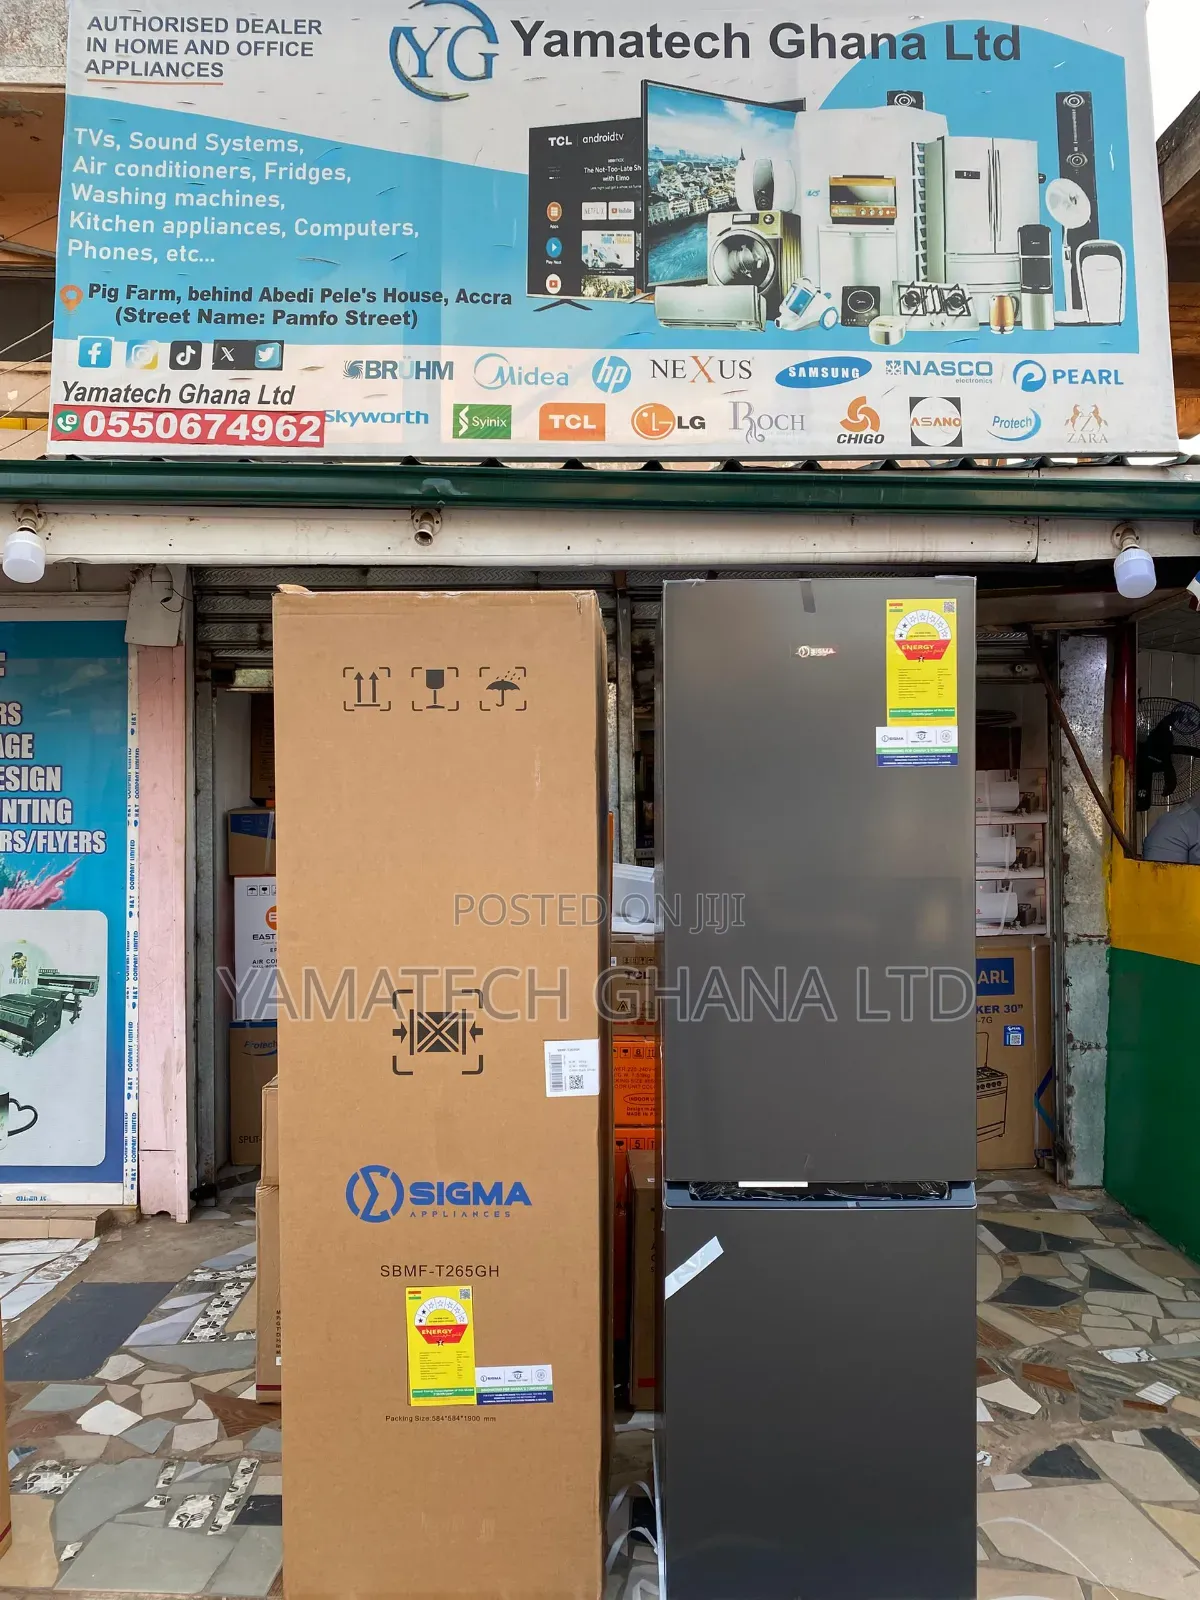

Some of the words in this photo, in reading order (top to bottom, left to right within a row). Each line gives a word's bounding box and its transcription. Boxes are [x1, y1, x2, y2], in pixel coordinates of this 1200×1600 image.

[87, 16, 229, 33] AUTHORISED
[235, 18, 323, 35] DEALER
[86, 37, 107, 53] IN
[115, 38, 178, 55] HOME
[184, 40, 230, 56] AND
[237, 41, 314, 57] OFFICE
[511, 20, 752, 60] Yamatech
[770, 21, 928, 61] Ghana
[946, 23, 1021, 62] Ltd
[85, 59, 224, 78] APPLIANCES
[74, 127, 121, 150] TVs,
[129, 131, 198, 152] Sound
[205, 132, 304, 157] Systems,
[548, 136, 572, 147] TCL
[582, 132, 625, 144] androidtv
[72, 156, 107, 175] Air
[114, 159, 256, 183] conditioners,
[264, 162, 352, 185] Fridges,
[71, 184, 166, 209] Washing
[174, 189, 285, 211] machines,
[69, 211, 154, 233] Kitchen
[163, 215, 286, 238] appliances,
[294, 219, 420, 241] Computers,
[67, 239, 159, 265] Phones,
[166, 245, 215, 263] etc...
[88, 284, 119, 304] Pig
[126, 286, 182, 305] Farm,
[188, 286, 253, 304] behind
[259, 288, 315, 304] Abedi
[320, 288, 377, 305] Pele's
[383, 288, 449, 307] House,
[455, 289, 512, 306] Accra
[115, 308, 190, 329] (Street
[197, 309, 265, 326] Name:
[272, 309, 339, 327] Pamfo
[345, 310, 419, 329] Street)
[364, 359, 454, 381] BRÜHM
[497, 365, 569, 386] Midea
[596, 357, 626, 393] hp
[650, 356, 752, 384] NEXUS
[788, 366, 861, 380] SAMSUNG
[903, 360, 994, 376] NASCO
[1052, 369, 1124, 386] PEARL
[61, 381, 173, 405] Yamatech
[178, 382, 251, 406] Ghana
[258, 383, 296, 406] Ltd
[82, 409, 322, 443] 0550674962
[324, 409, 430, 430] Skyworth
[472, 415, 507, 429] Syinix
[549, 414, 596, 430] TCL
[677, 415, 706, 430] LG
[728, 401, 805, 444] ROCH
[911, 416, 962, 428] ASANO
[992, 415, 1032, 430] Protech
[836, 433, 885, 445] CHIGO
[1066, 432, 1109, 444] ZARA
[977, 970, 1009, 984] ARL
[409, 1181, 533, 1206] SIGMA
[410, 1210, 511, 1219] APPLIANCES
[380, 1264, 500, 1278] SBMF-T265GH
[385, 1414, 413, 1424] Packing
